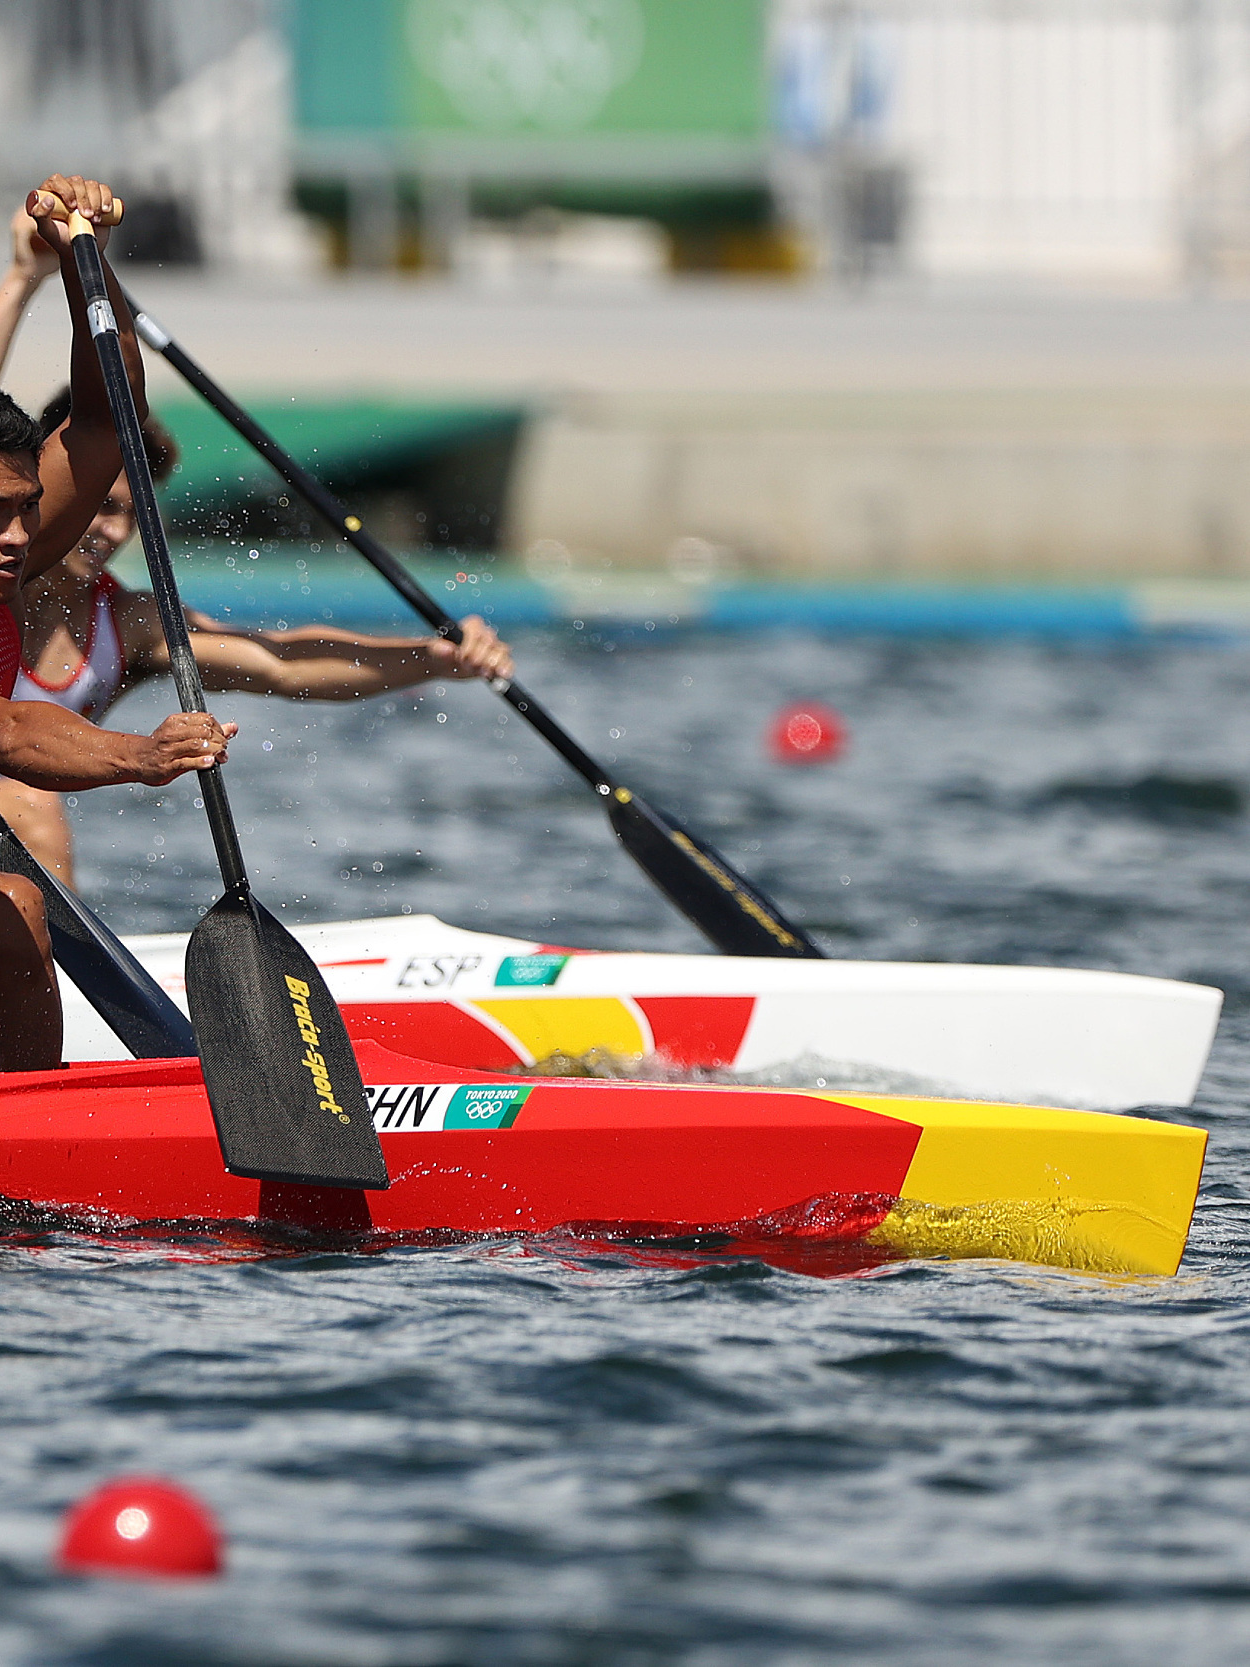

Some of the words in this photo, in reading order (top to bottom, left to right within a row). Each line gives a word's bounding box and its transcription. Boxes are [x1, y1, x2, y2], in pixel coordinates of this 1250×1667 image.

[398, 956, 482, 988] ESP
[362, 1086, 441, 1129] HN
[465, 1090, 496, 1100] TOKYO
[494, 1089, 519, 1099] 2020
